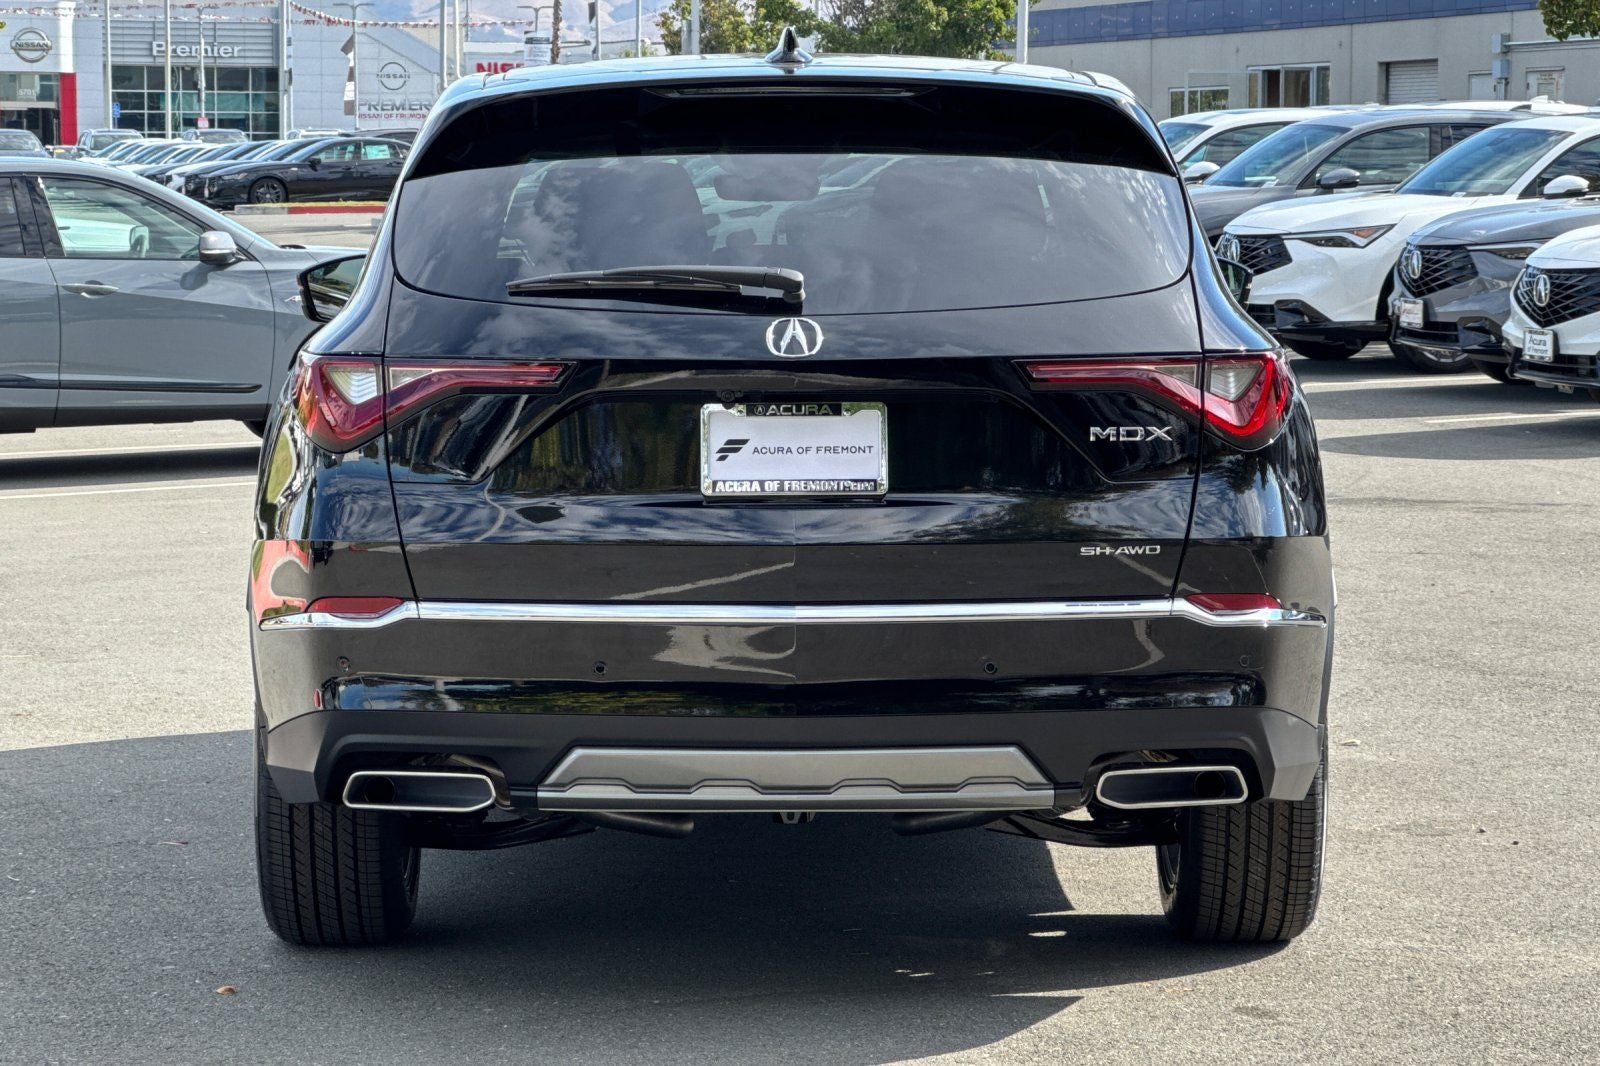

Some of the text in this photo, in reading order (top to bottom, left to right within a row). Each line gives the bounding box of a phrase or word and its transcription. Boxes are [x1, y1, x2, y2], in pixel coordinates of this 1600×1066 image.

[152, 41, 241, 57] Premier
[358, 101, 433, 111] PREMER
[766, 404, 833, 415] ACURA
[1089, 426, 1173, 441] MDX
[752, 445, 874, 455] ACURA OF FREMONT
[764, 481, 781, 491] OF
[1080, 545, 1160, 555] SH-AWD
